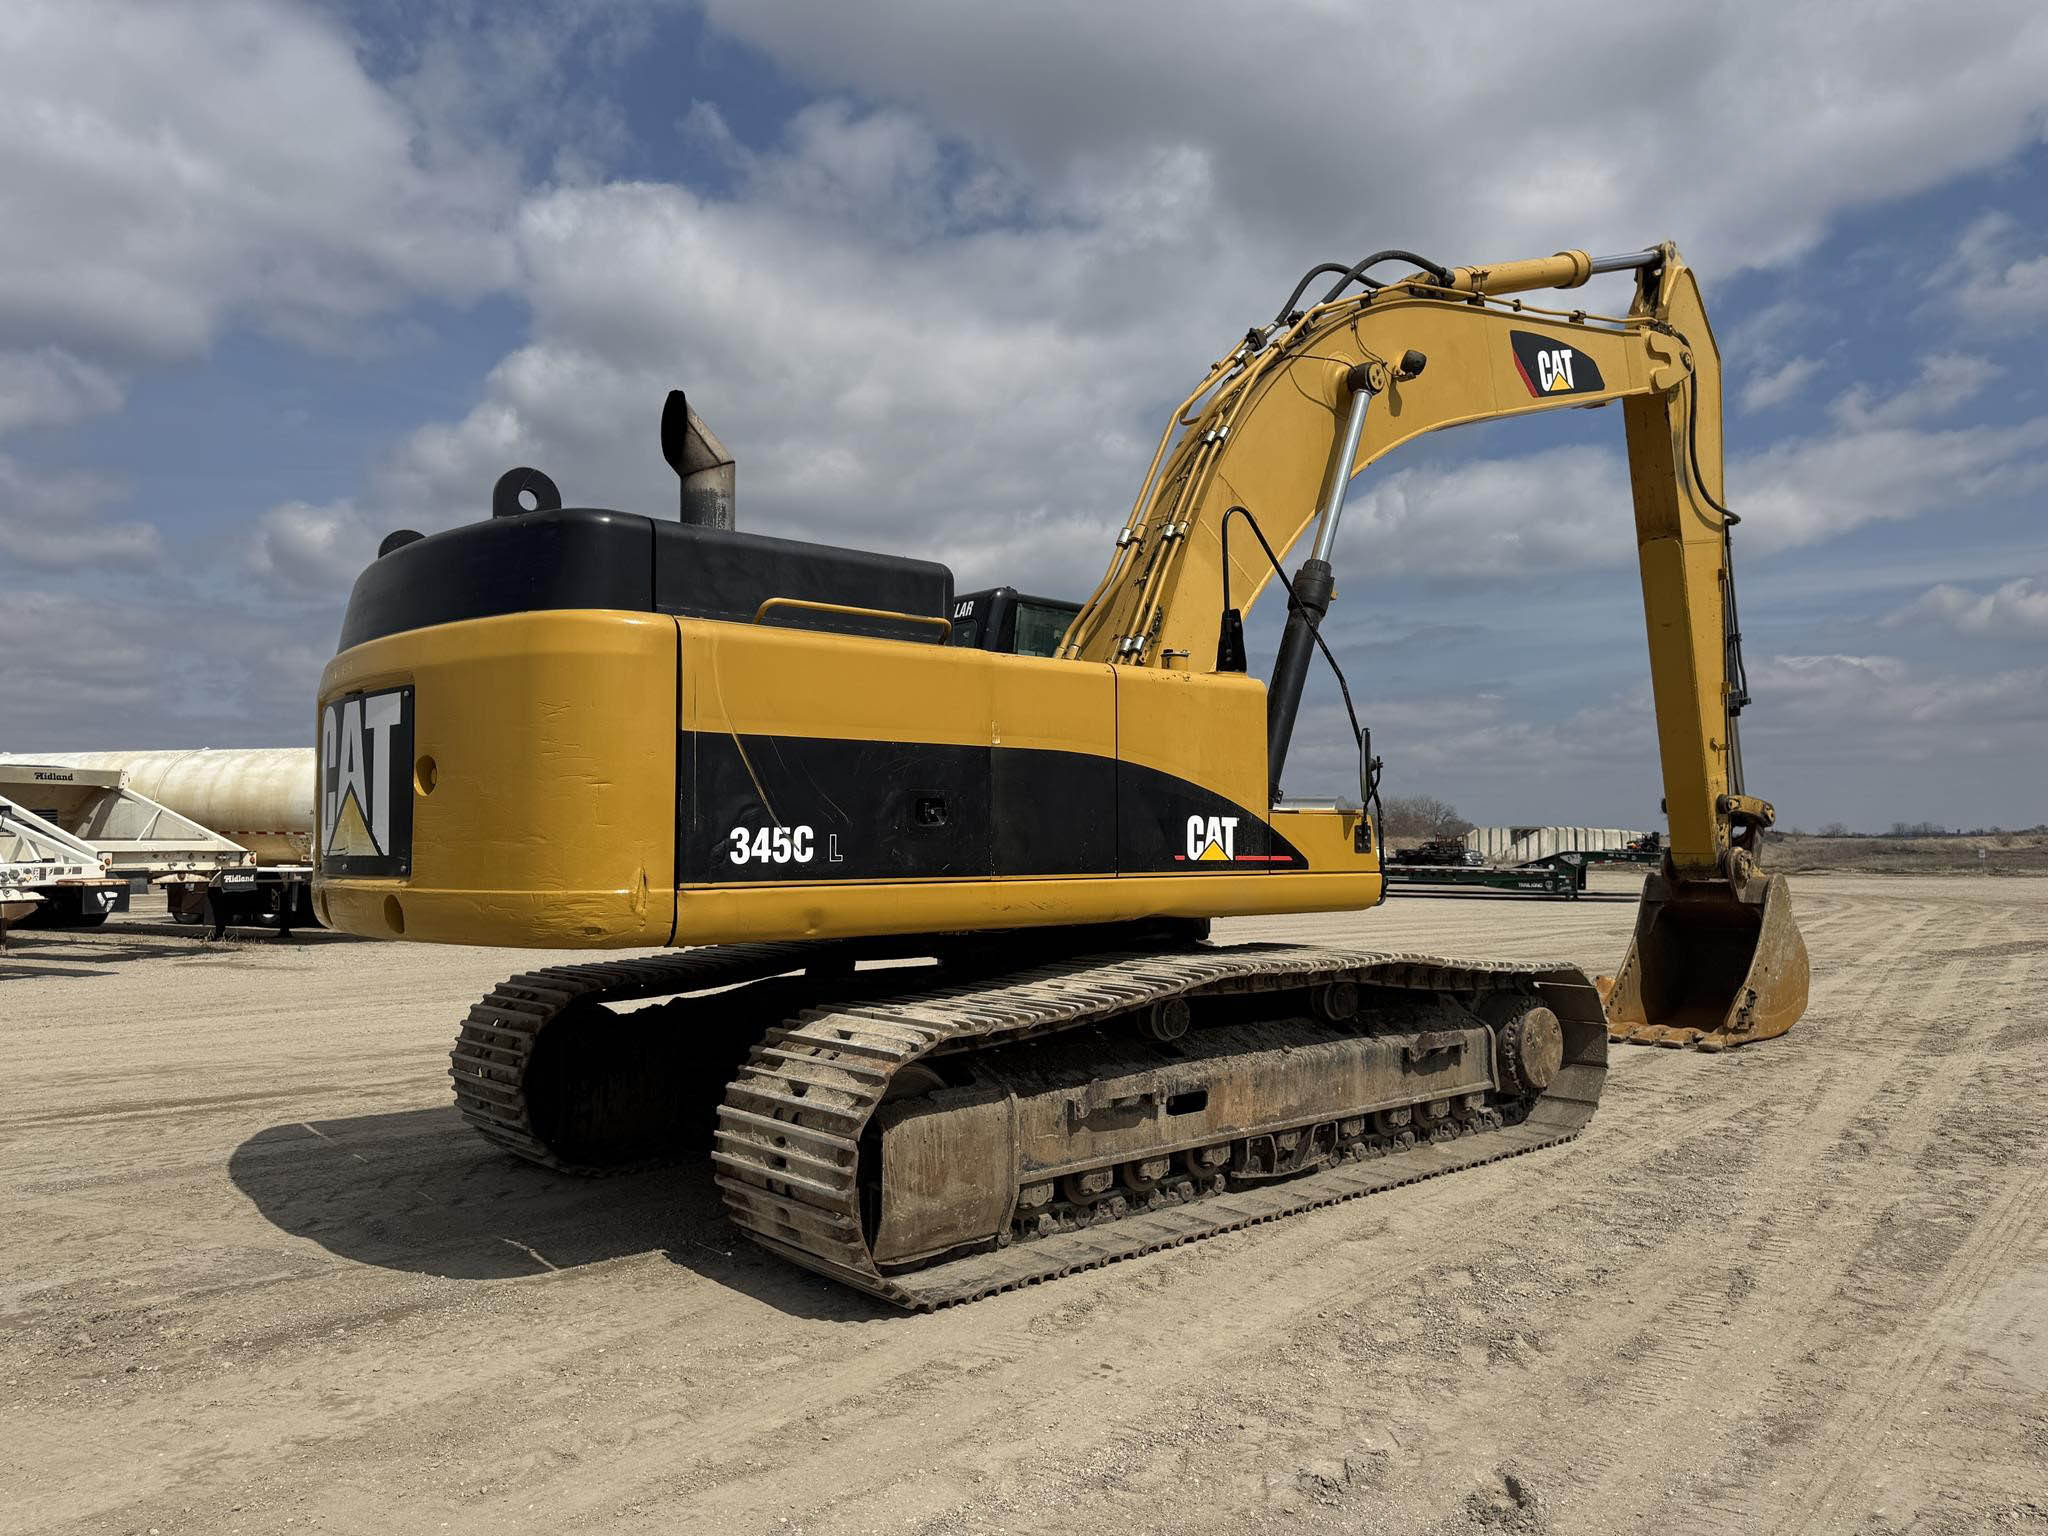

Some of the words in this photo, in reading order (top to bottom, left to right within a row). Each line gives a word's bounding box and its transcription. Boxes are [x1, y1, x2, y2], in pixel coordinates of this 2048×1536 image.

[1537, 349, 1575, 392] CAT
[954, 600, 975, 619] LAR
[34, 771, 74, 781] Midland
[322, 691, 402, 857] CAT
[729, 825, 814, 865] 345C
[829, 833, 844, 862] L
[1186, 815, 1239, 861] CAT
[223, 874, 255, 883] Midland
